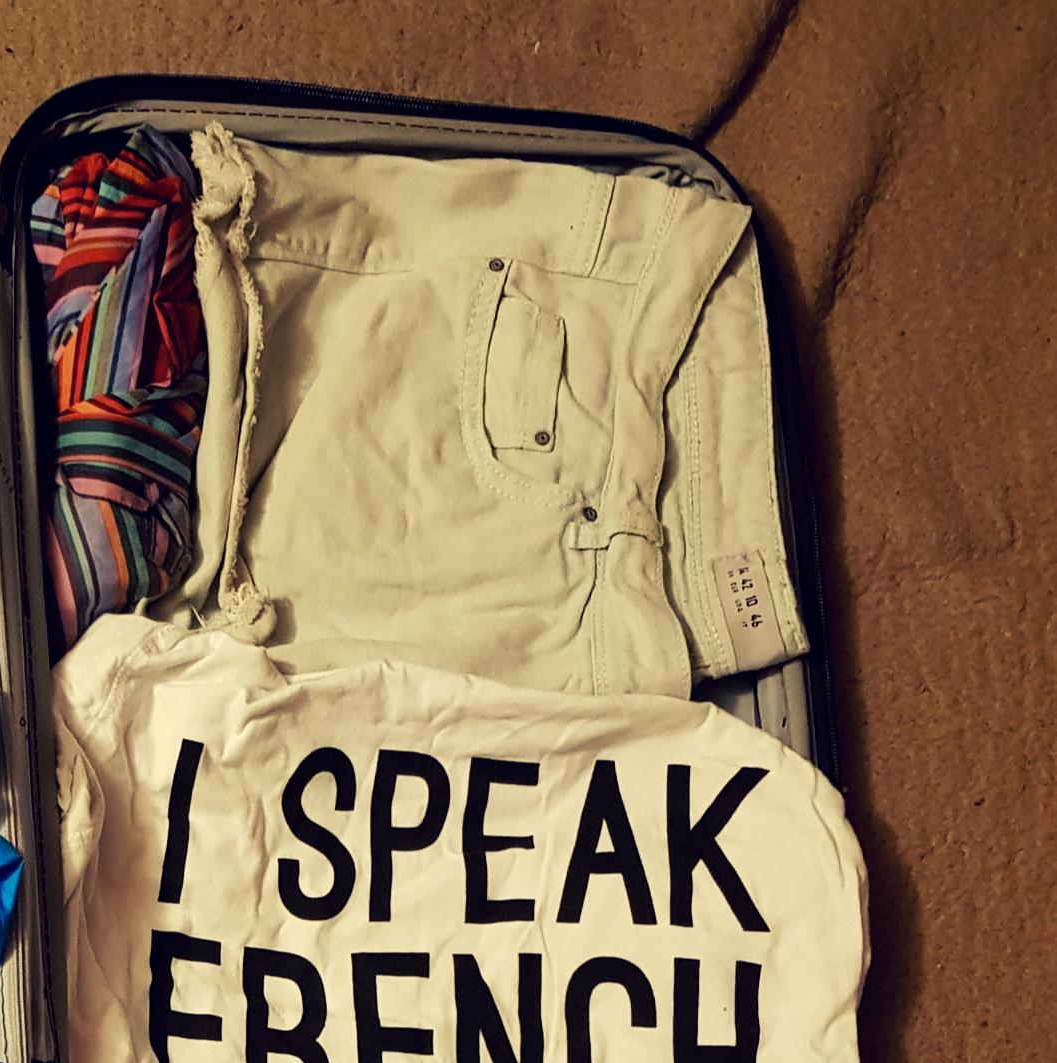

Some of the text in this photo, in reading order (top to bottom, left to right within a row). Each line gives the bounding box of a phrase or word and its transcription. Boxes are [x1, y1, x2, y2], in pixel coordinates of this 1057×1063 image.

[741, 578, 754, 591] 42
[745, 594, 758, 608] 10
[750, 614, 764, 628] 46
[158, 739, 770, 932] I SPEAK
